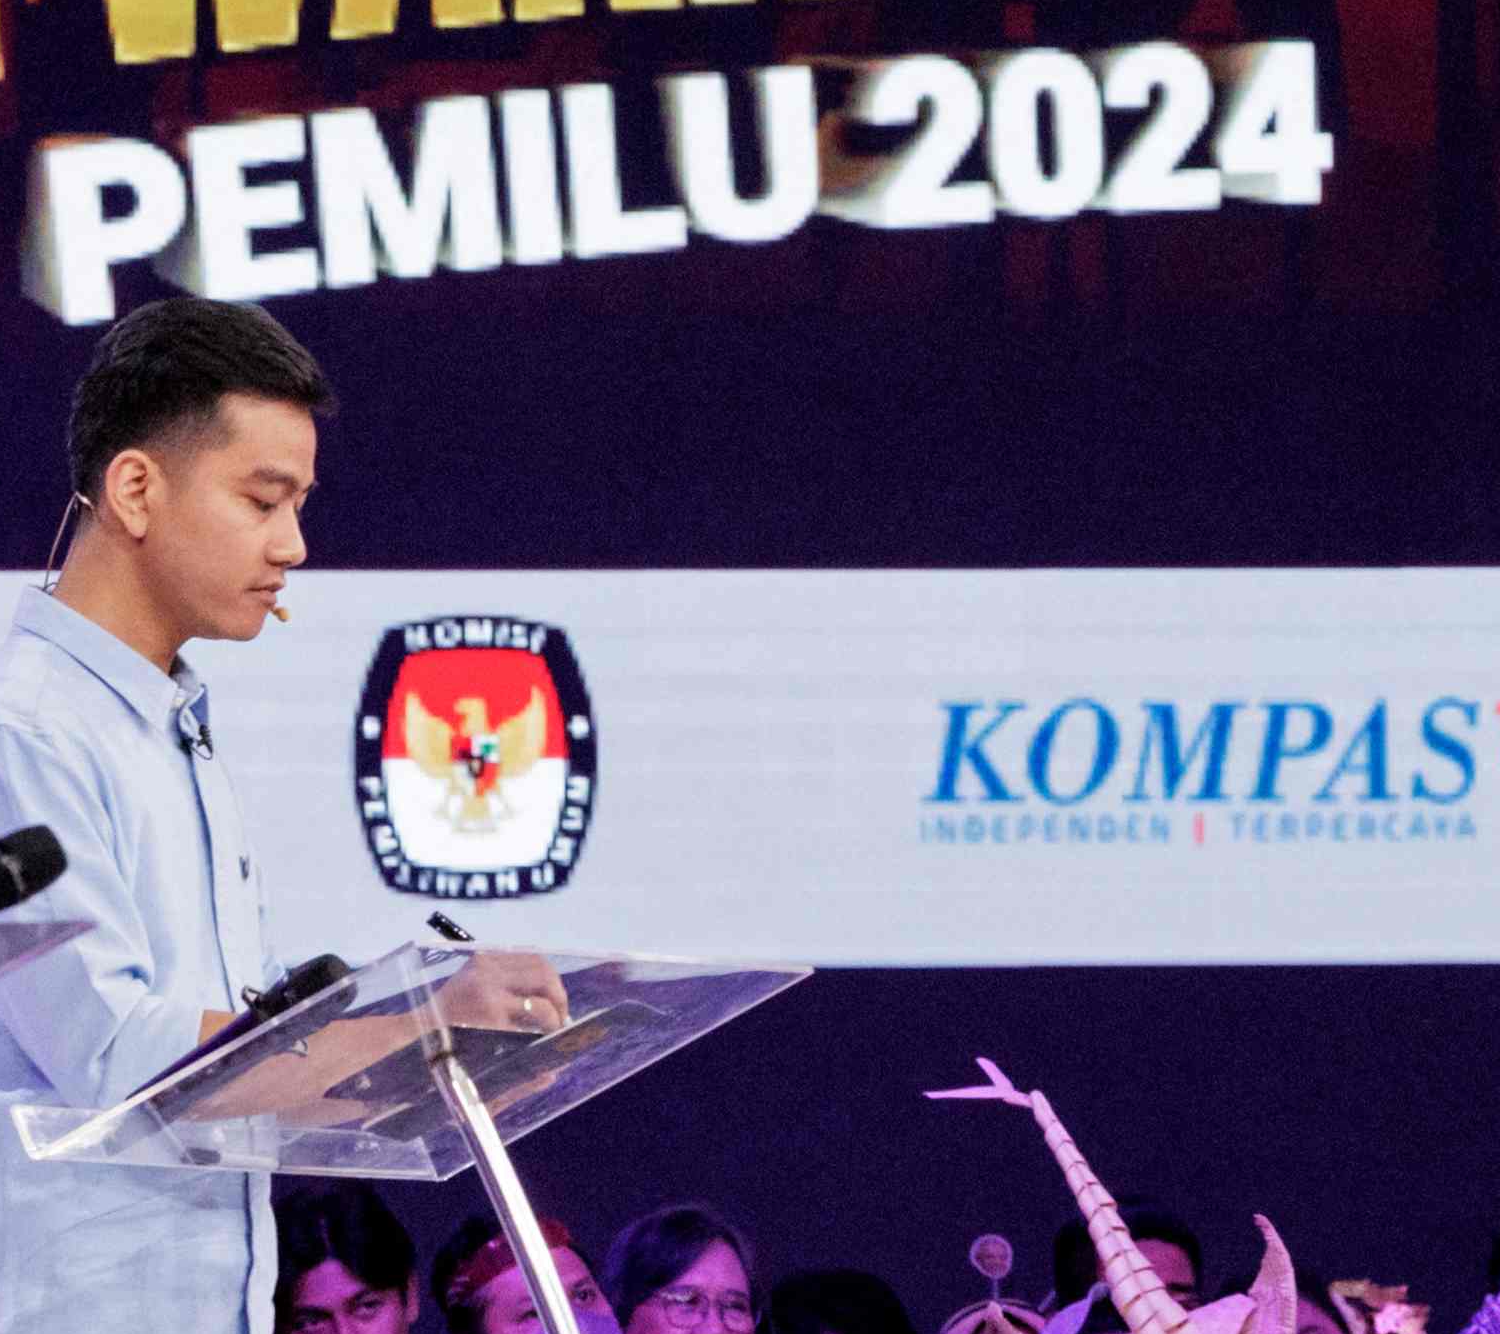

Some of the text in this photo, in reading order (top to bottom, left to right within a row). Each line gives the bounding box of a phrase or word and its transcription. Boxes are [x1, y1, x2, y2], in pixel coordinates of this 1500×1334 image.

[30, 37, 1336, 325] PEMILU 2024
[919, 696, 1481, 805] KOMPAS
[918, 813, 1478, 845] INDEPENDEN TERPERCAYA
